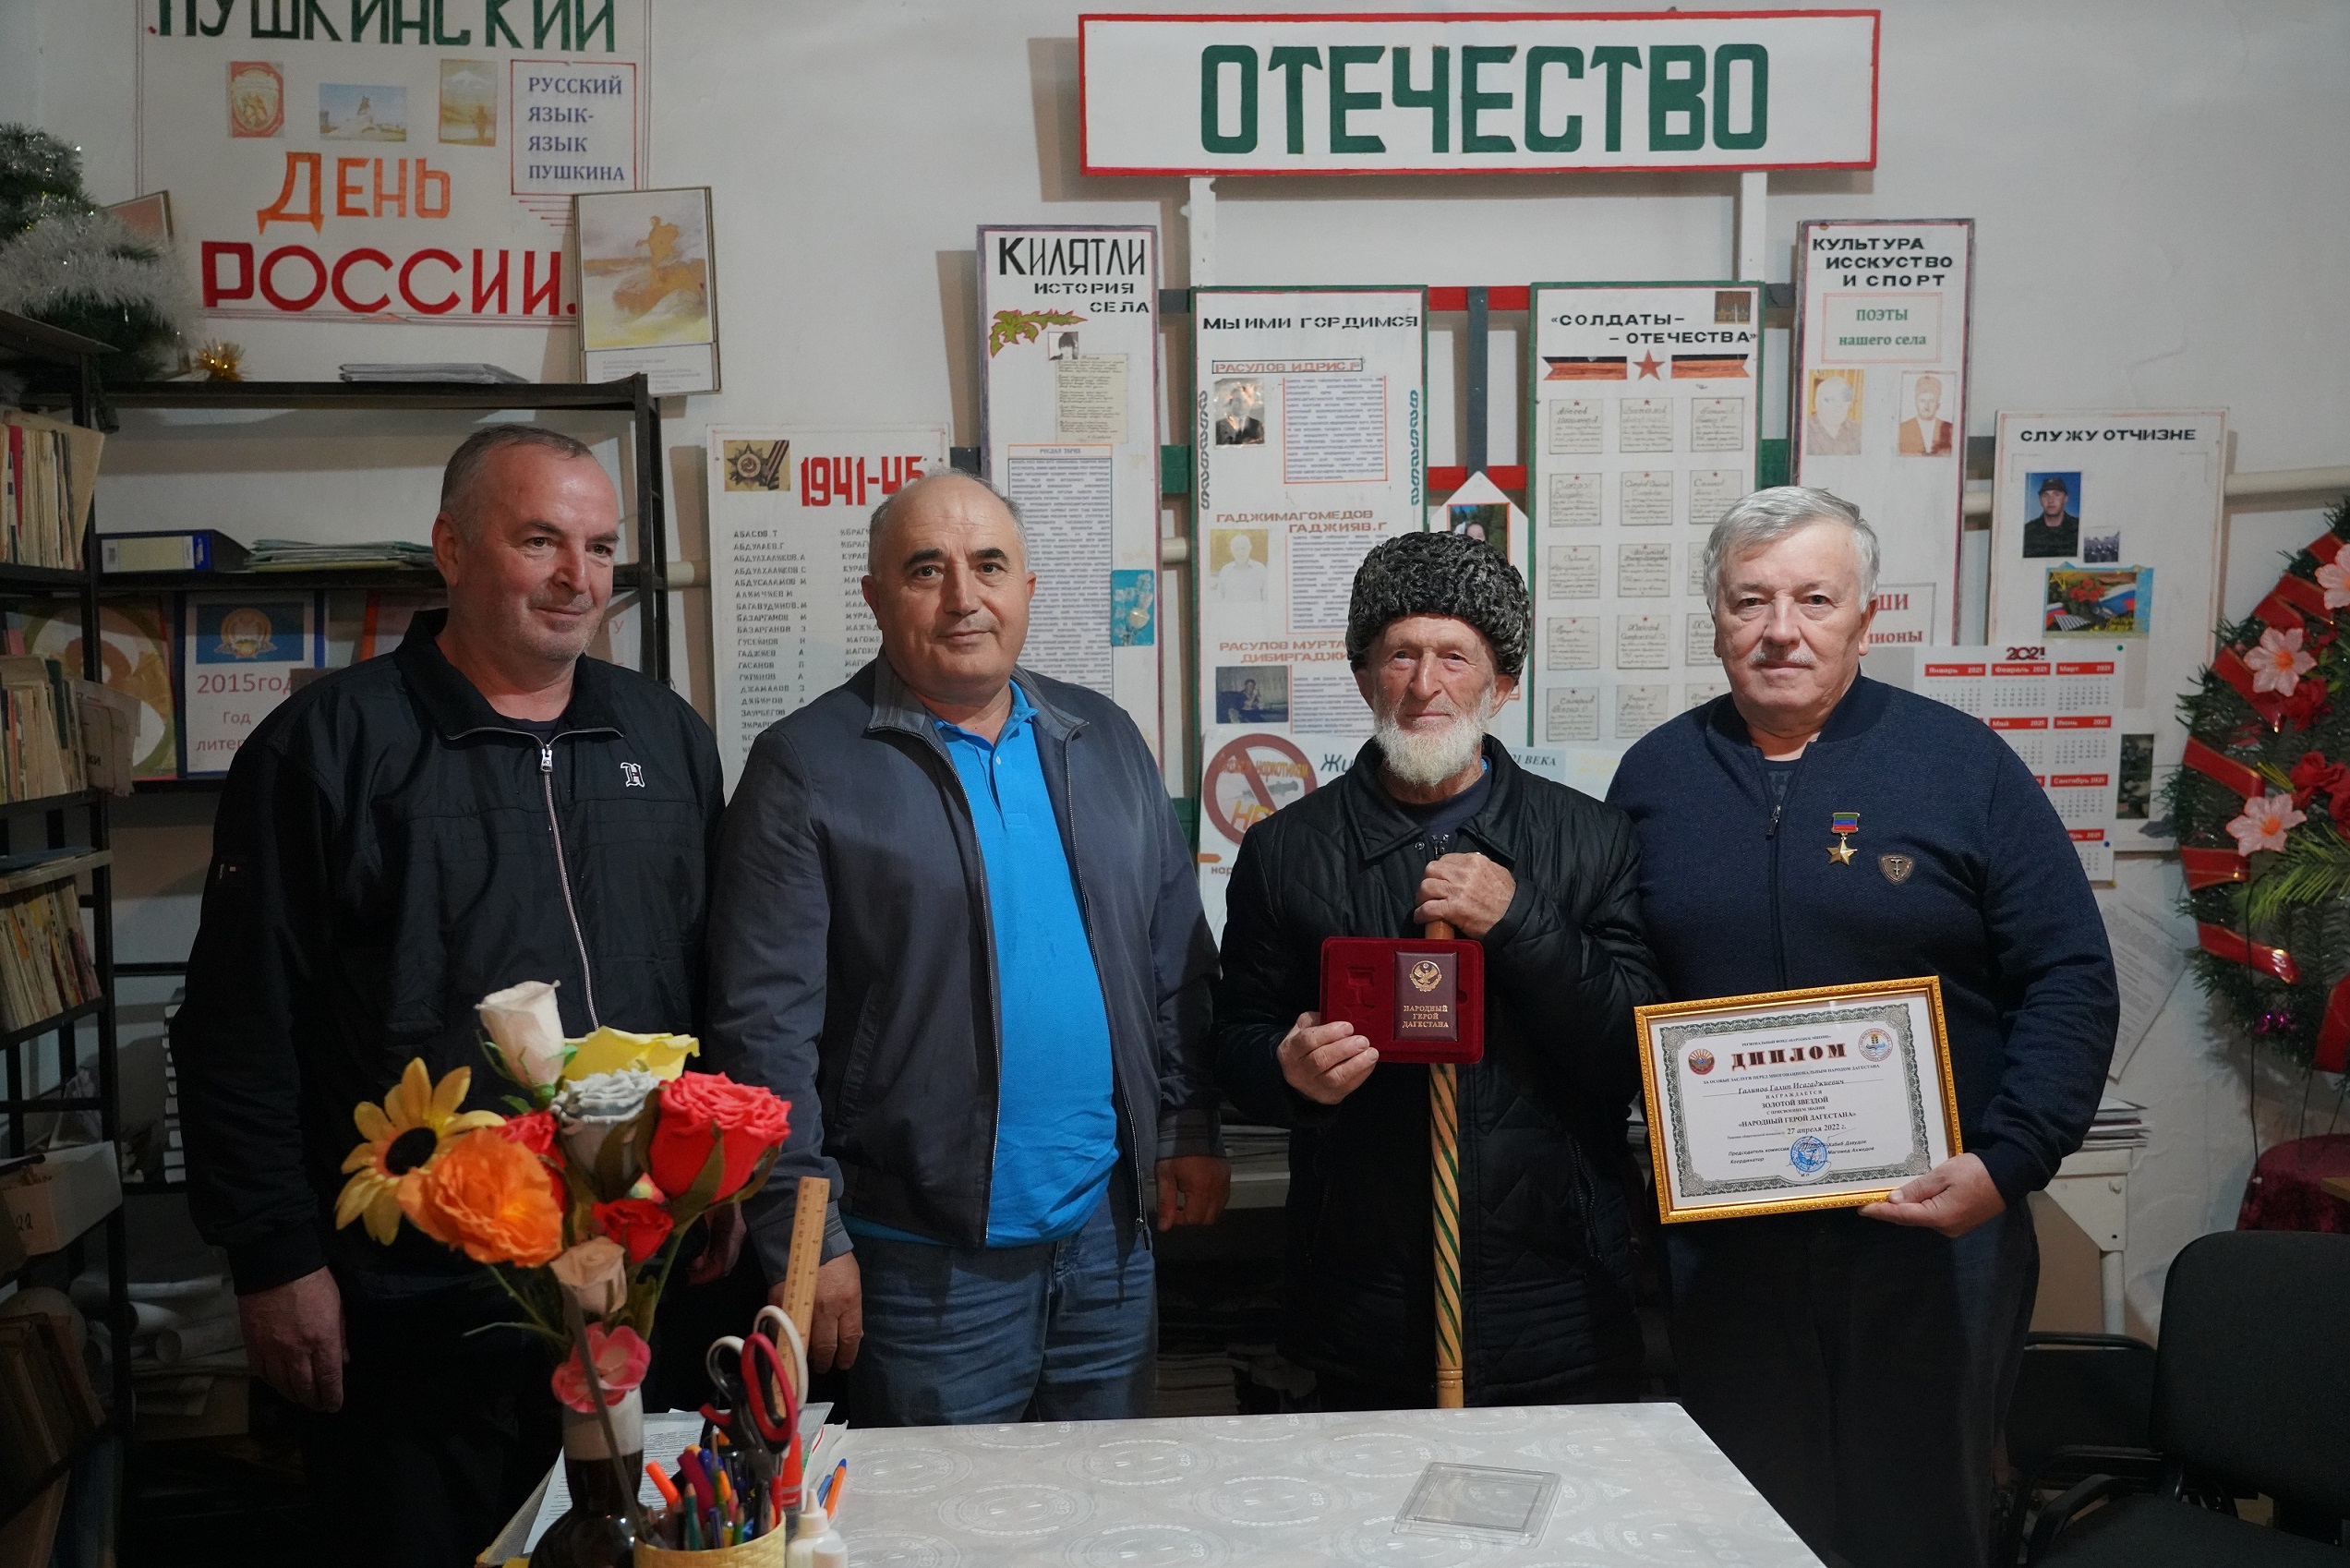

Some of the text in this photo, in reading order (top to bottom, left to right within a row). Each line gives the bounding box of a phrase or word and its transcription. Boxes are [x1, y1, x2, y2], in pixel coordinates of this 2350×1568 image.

[528, 75, 622, 95] РУССКИЙ
[1200, 42, 1770, 155] ОТЕЧЕСТВО
[528, 106, 595, 123] ЯЗЫК-
[528, 136, 588, 152] ЯЗЫК
[528, 164, 625, 181] ПУШКИНА
[257, 151, 452, 235] ДЕНЬ
[1812, 237, 1925, 250] КУЛЬТУРА
[1826, 256, 1954, 270] ИССКУСТВО
[1843, 274, 1945, 287] И СПОРТ
[1034, 282, 1135, 295] ИСТОРИЯ
[1090, 301, 1150, 313] СЕЛА
[1856, 308, 1909, 322] ПОЭТЫ
[1203, 316, 1418, 330] МЫ ИМИ ГОРДИМСЯ
[1838, 334, 1927, 347] нашего села
[1214, 363, 1286, 373] РАСУЛОВ
[2020, 428, 2197, 442] СЛУЖУ ОТЧИЗНЕ
[1216, 510, 1374, 523] ГАДЖИМАГОМЕДОВ
[1219, 642, 1289, 652] РАСУЛОВ
[2006, 646, 2045, 660] 2021
[223, 711, 252, 726] Год
[1524, 754, 1557, 766] ВЕКА
[1403, 1004, 1449, 1012] НАРОДНЫЙ
[1730, 1043, 1848, 1072] ДИПЛОМ
[1762, 1096, 1828, 1108] ЗОЛОТОЙ ЗВЕЗДОЙ
[1784, 1115, 1808, 1123] ГЕРОЙ
[1796, 1126, 1822, 1135] апреля
[1824, 1123, 1840, 1131] 2022
